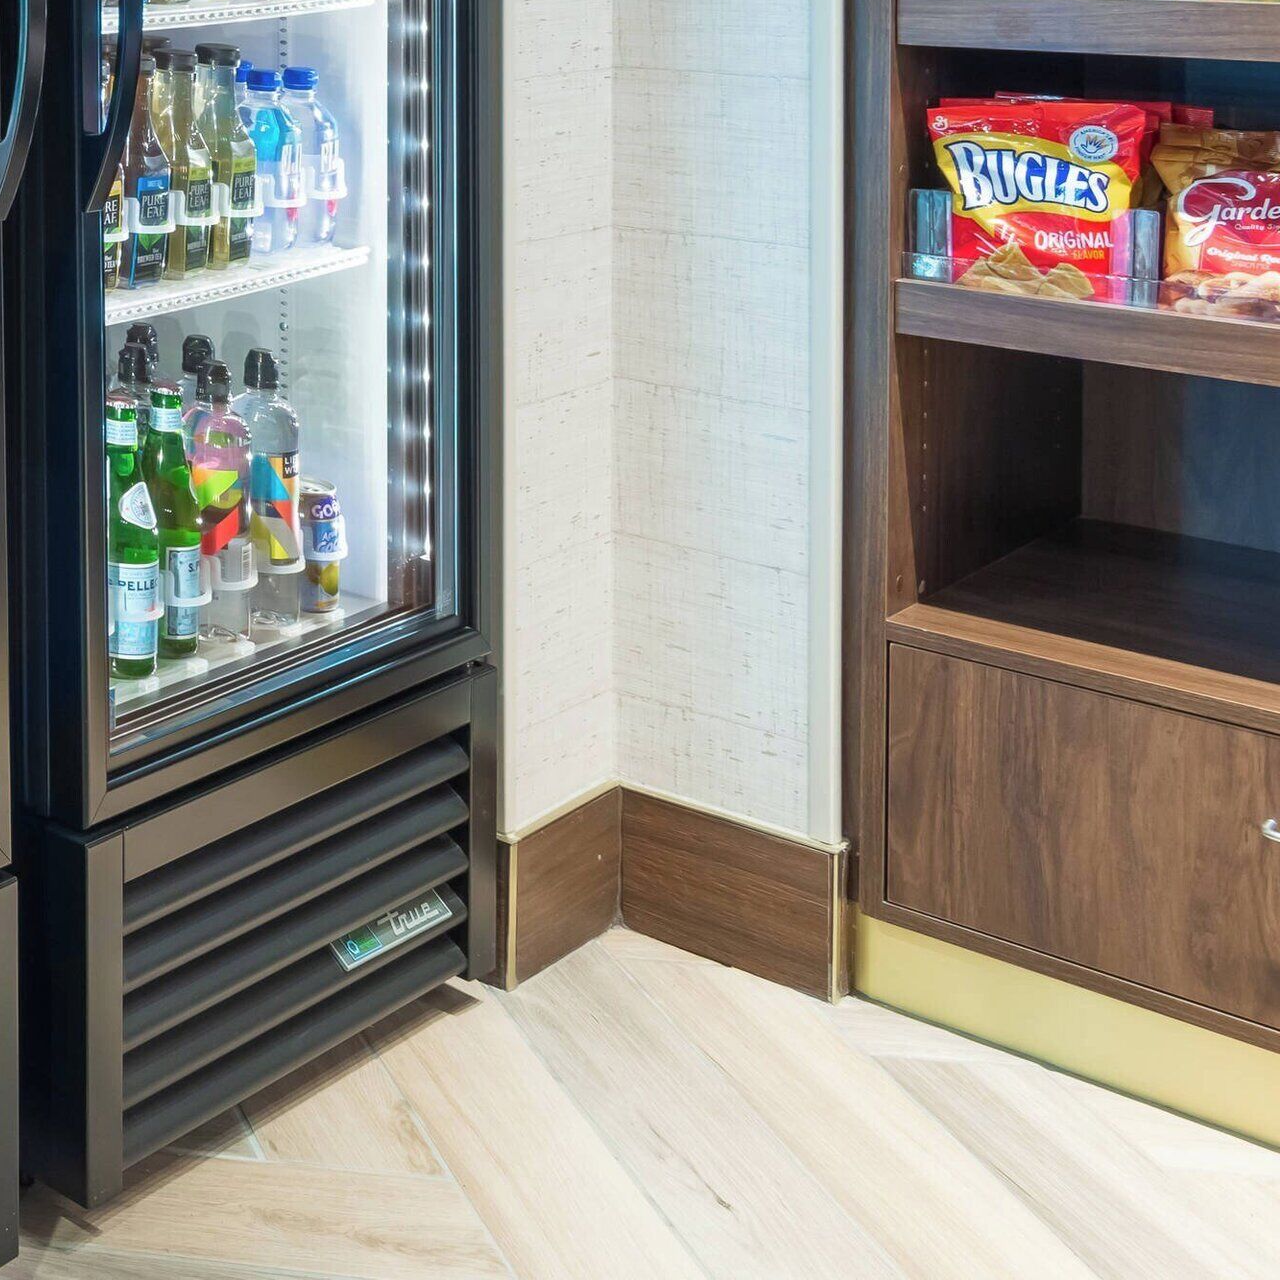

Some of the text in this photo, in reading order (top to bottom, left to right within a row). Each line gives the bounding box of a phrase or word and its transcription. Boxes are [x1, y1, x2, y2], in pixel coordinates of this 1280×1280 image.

[234, 175, 254, 188] PURE
[944, 139, 1110, 214] BUGLES
[233, 186, 254, 200] LEAF
[142, 194, 166, 208] PURE
[142, 205, 166, 219] LEAF
[1235, 223, 1265, 232] Quality
[1073, 250, 1105, 261] FLAVOR
[1206, 246, 1258, 262] Original
